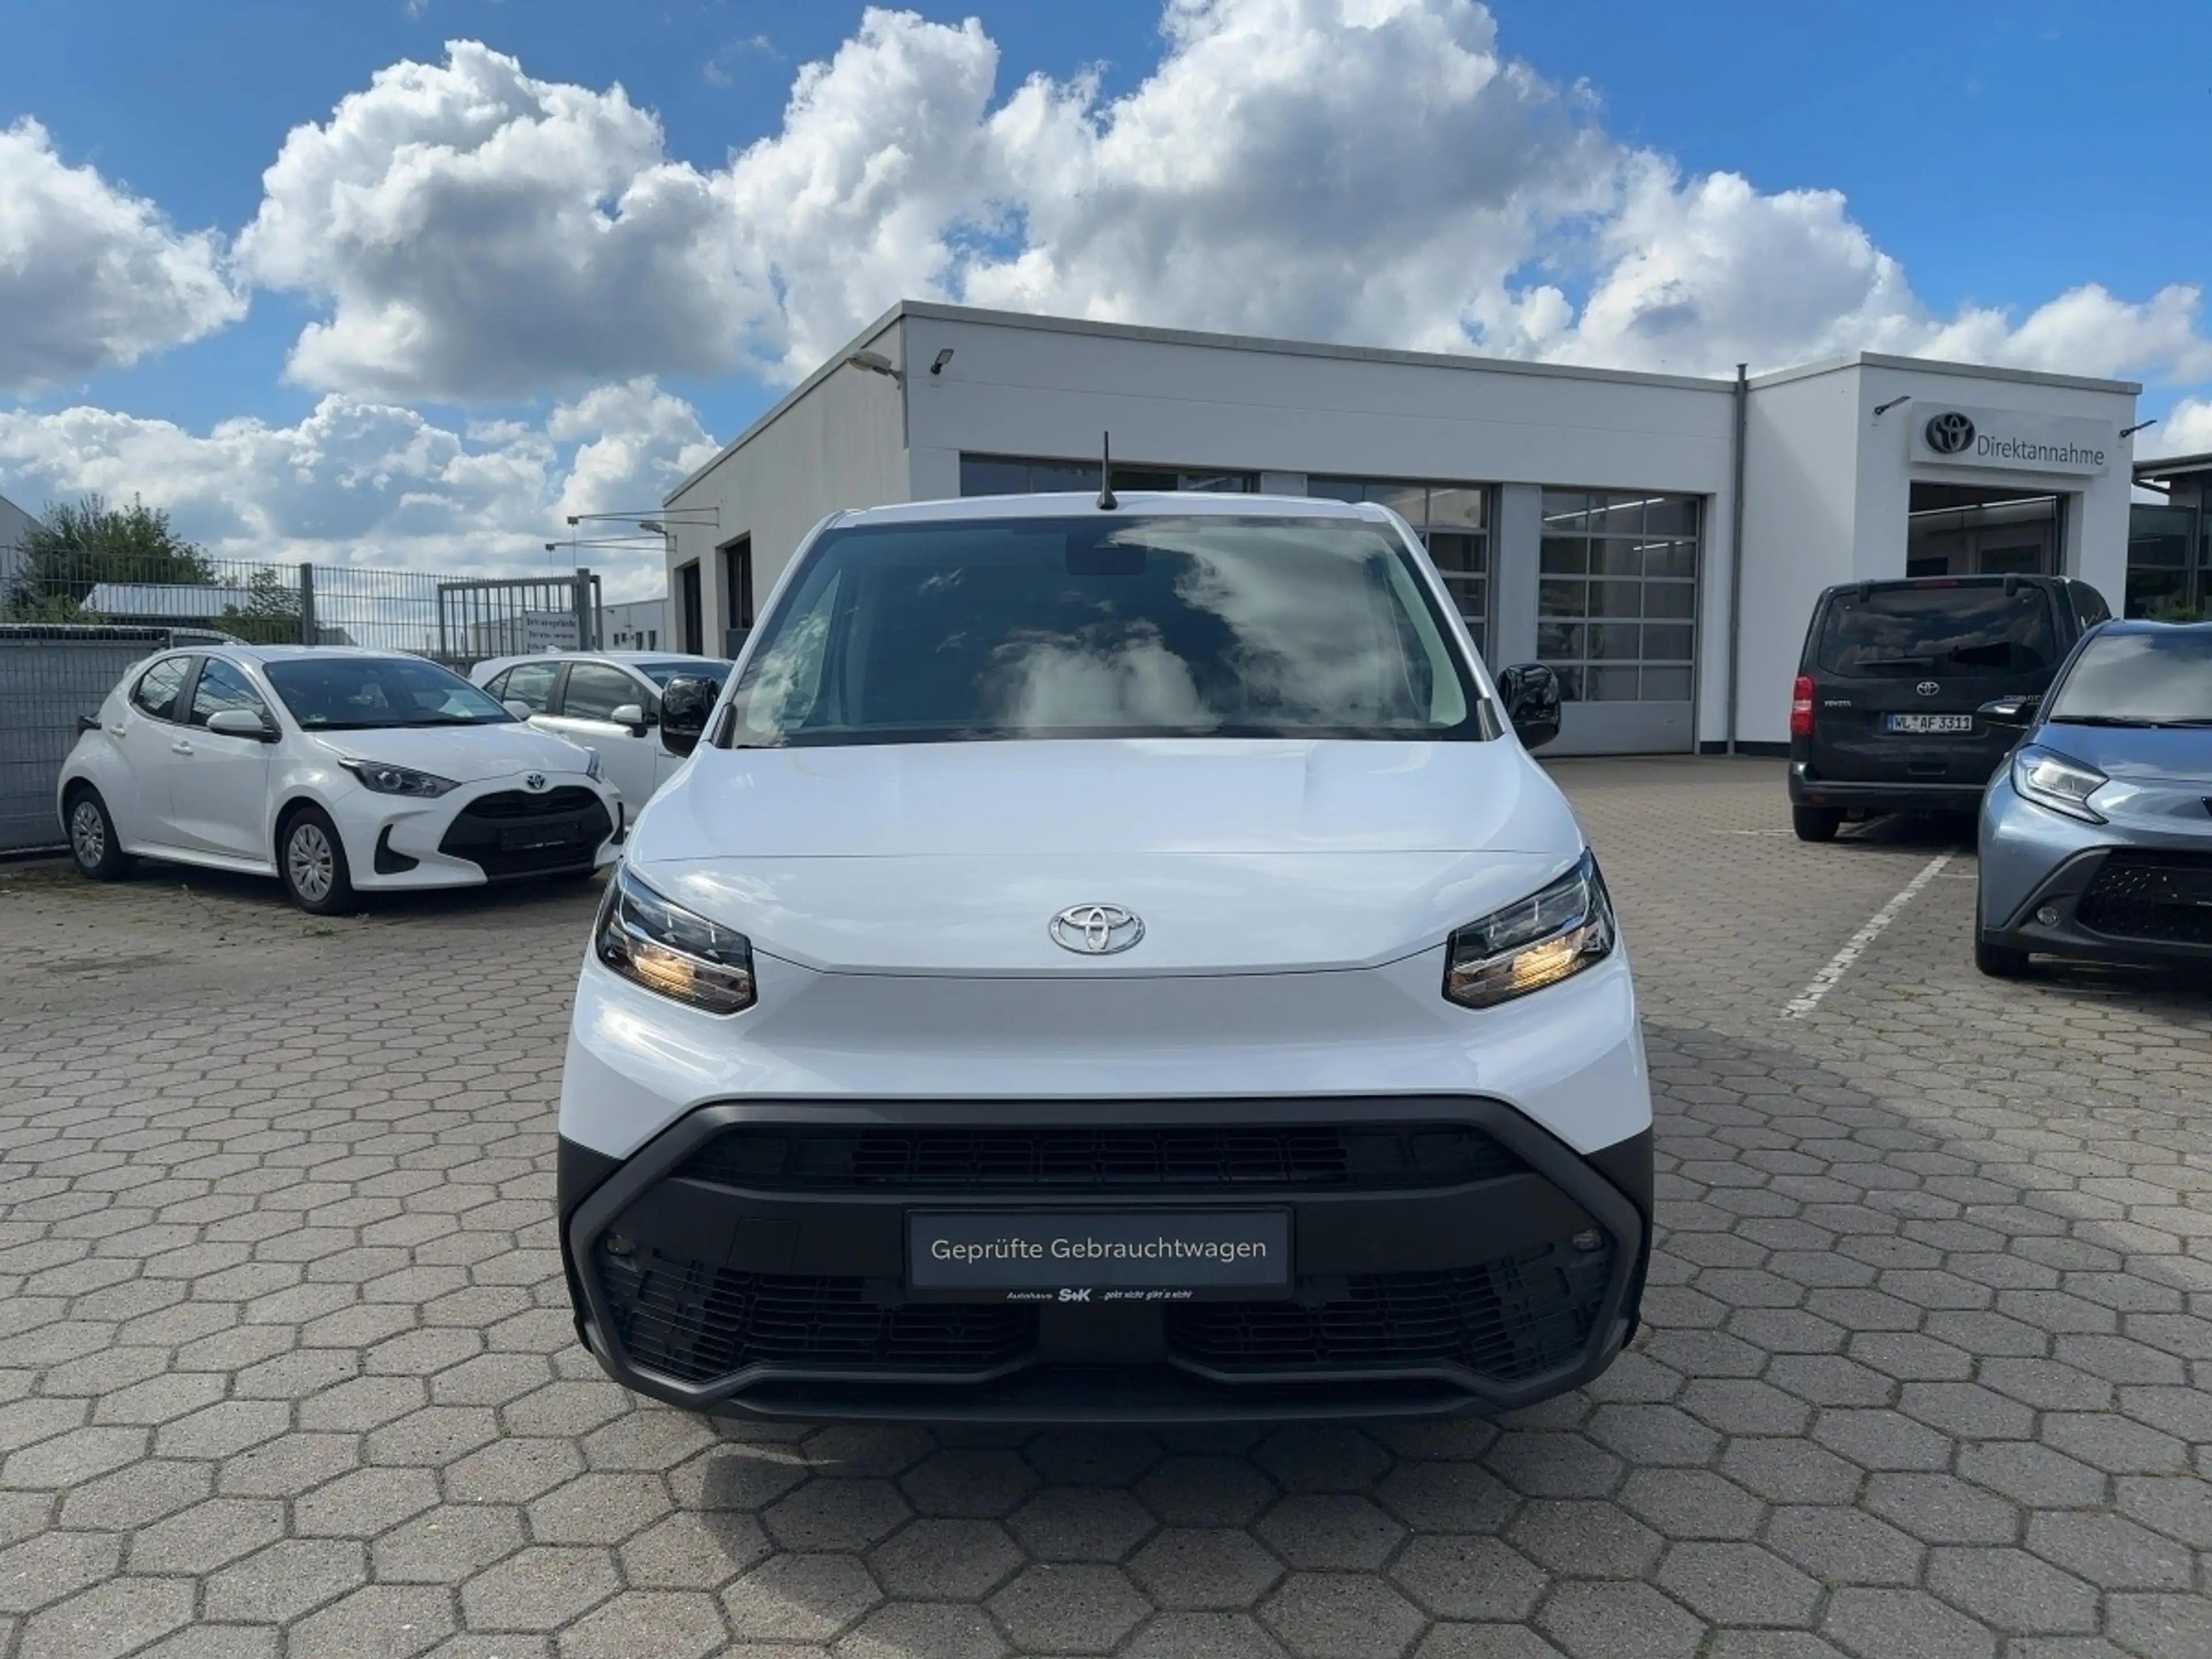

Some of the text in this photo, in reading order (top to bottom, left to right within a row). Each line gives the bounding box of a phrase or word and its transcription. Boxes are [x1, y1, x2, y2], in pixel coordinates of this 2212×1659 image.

[1977, 434, 2105, 465] Direktannahme
[1895, 717, 1969, 729] WL AF 3311
[931, 1237, 1266, 1264] Geprüfte Gebrauchtwagen
